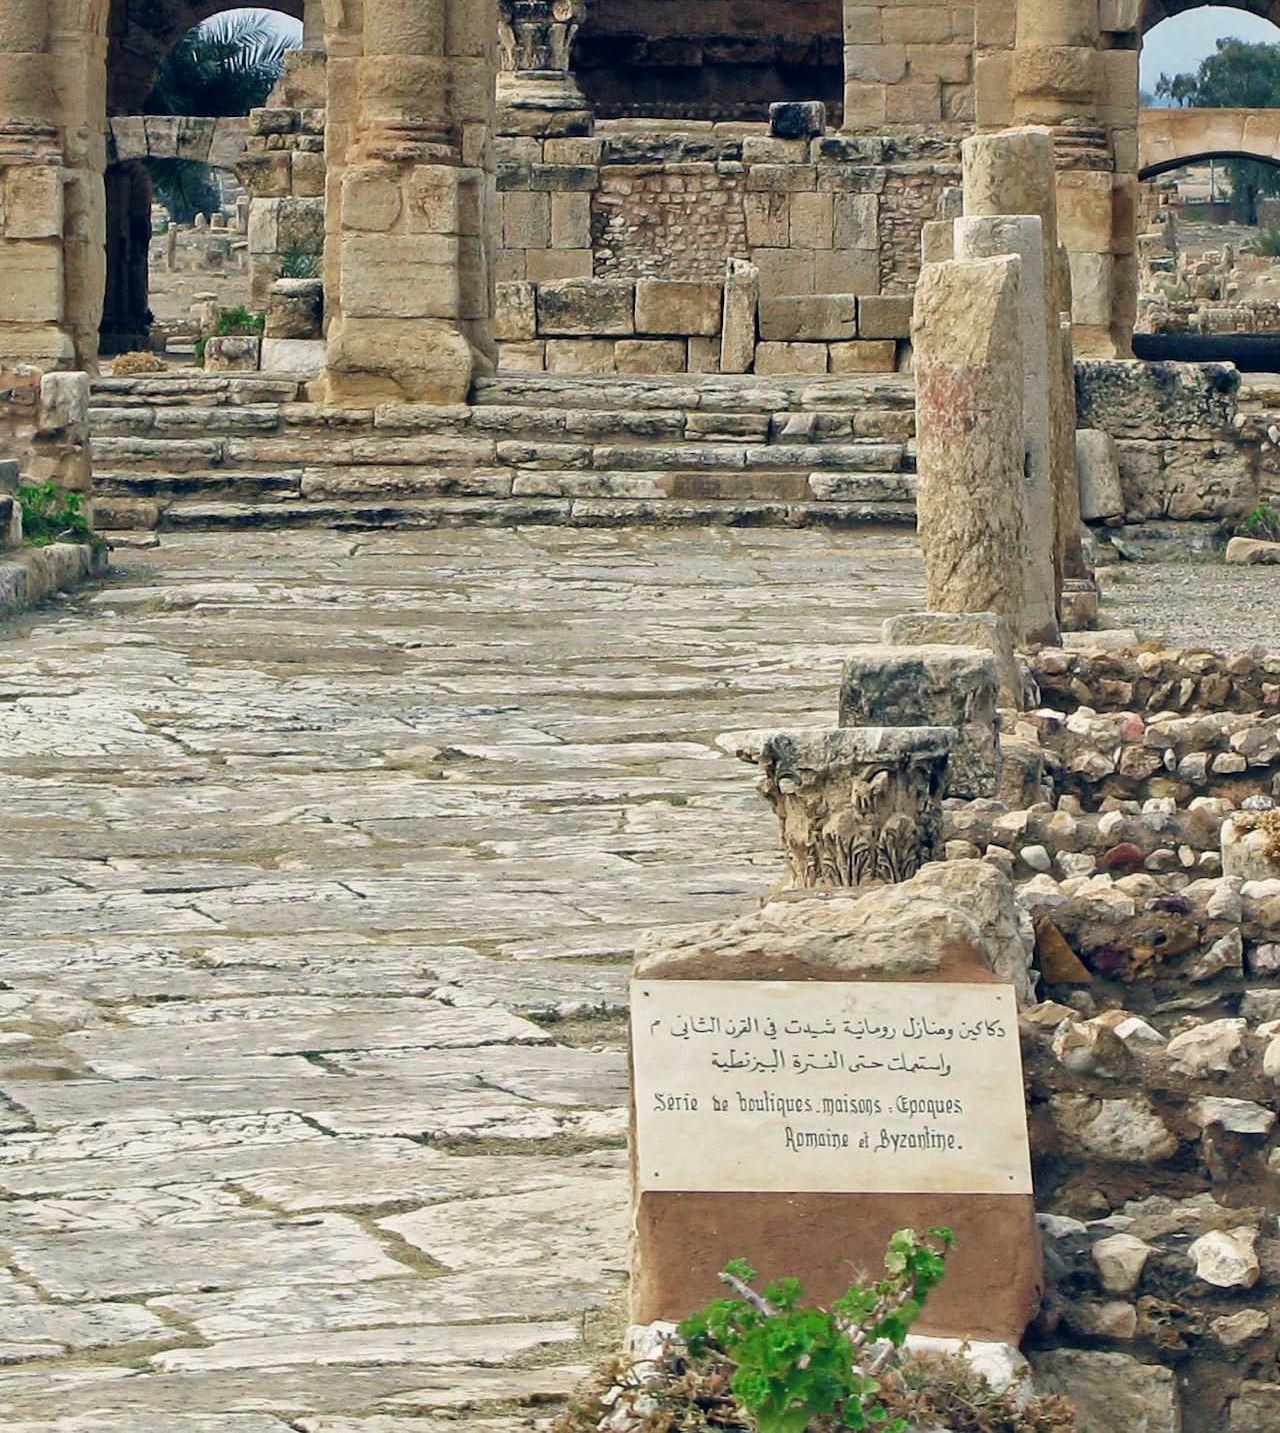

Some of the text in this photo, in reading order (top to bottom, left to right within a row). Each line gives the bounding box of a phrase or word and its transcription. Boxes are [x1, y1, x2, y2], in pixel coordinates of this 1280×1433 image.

[670, 1015, 721, 1040] الثاني
[725, 1016, 759, 1039] القرن
[763, 1017, 777, 1040] في
[784, 1018, 836, 1039] شيدت
[842, 1017, 897, 1040] رومانية
[902, 1016, 954, 1041] ومنازل
[959, 1018, 1006, 1041] دكاكين
[711, 1048, 785, 1073] البيزنطية
[792, 1049, 845, 1075] الفترة
[887, 1052, 952, 1077] واستعملت
[711, 1094, 729, 1112] de
[785, 1125, 849, 1153] Romaine
[858, 1130, 870, 1149] et
